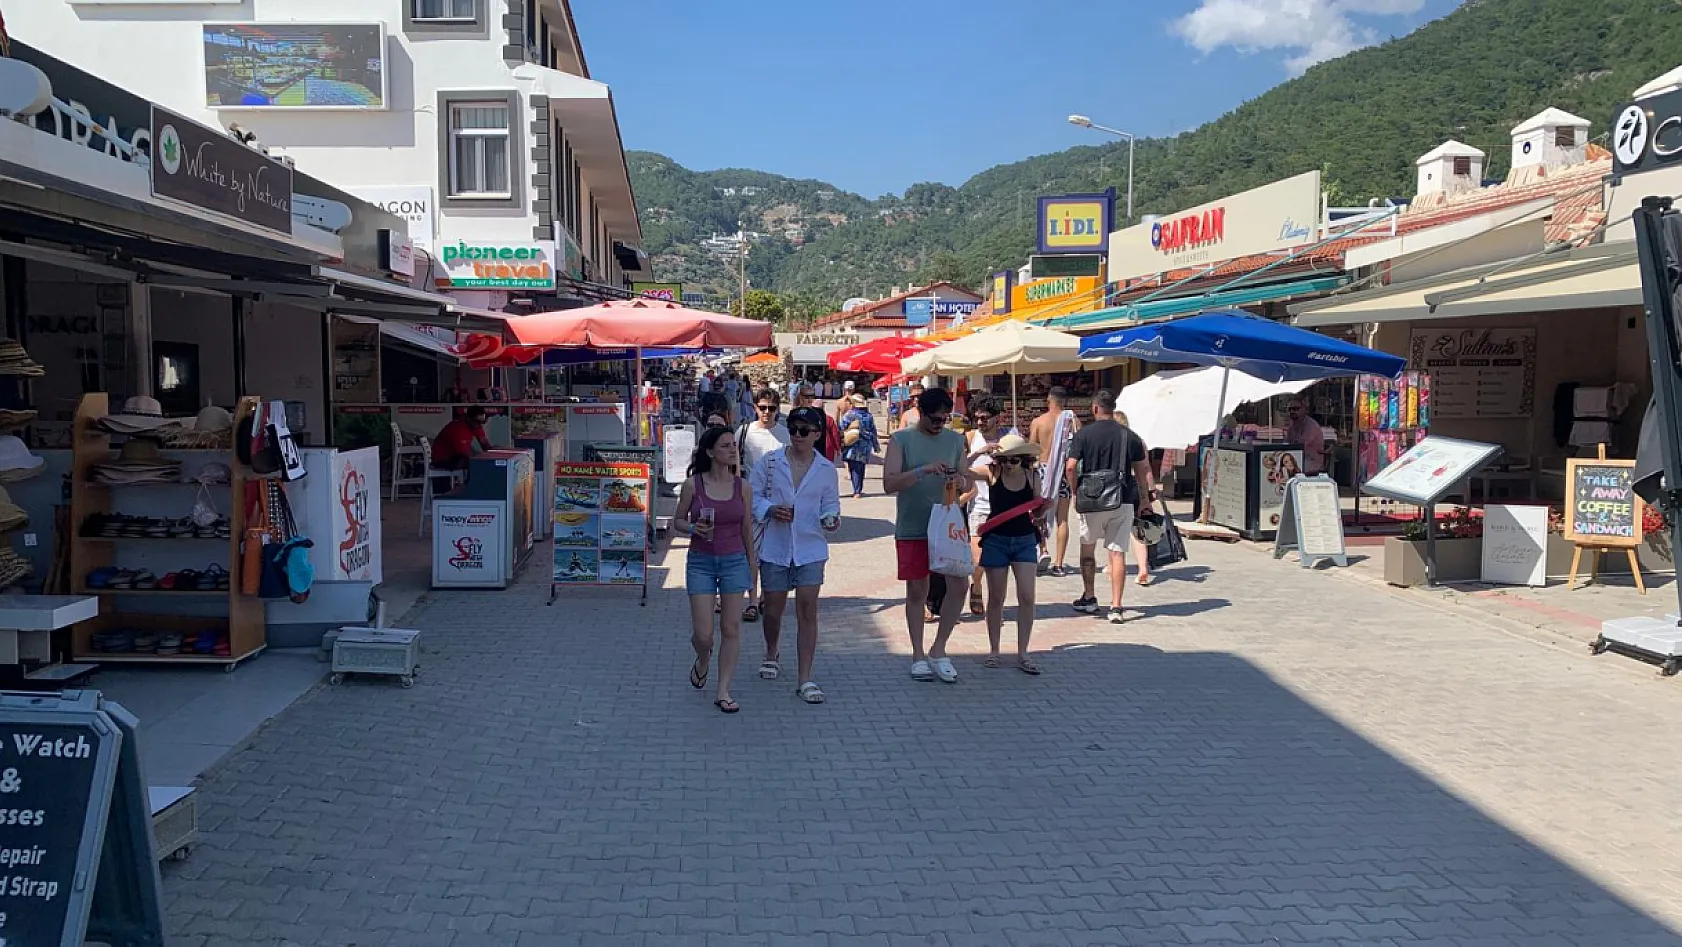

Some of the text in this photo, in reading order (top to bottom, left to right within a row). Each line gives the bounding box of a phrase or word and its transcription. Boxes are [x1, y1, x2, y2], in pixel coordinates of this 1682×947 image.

[182, 141, 290, 212] White by Nature
[442, 239, 542, 263] pioneer
[473, 261, 549, 279] travel
[573, 466, 594, 475] NAME
[594, 467, 618, 476] WATER
[618, 467, 642, 477] SPORTS
[1583, 475, 1618, 487] TAKE
[1591, 487, 1628, 499] AWAY
[1577, 500, 1631, 516] COFFEE
[1573, 521, 1633, 537] SANDWICH
[13, 733, 91, 759] Watch
[0, 767, 22, 794] &
[9, 876, 58, 901] Strap
